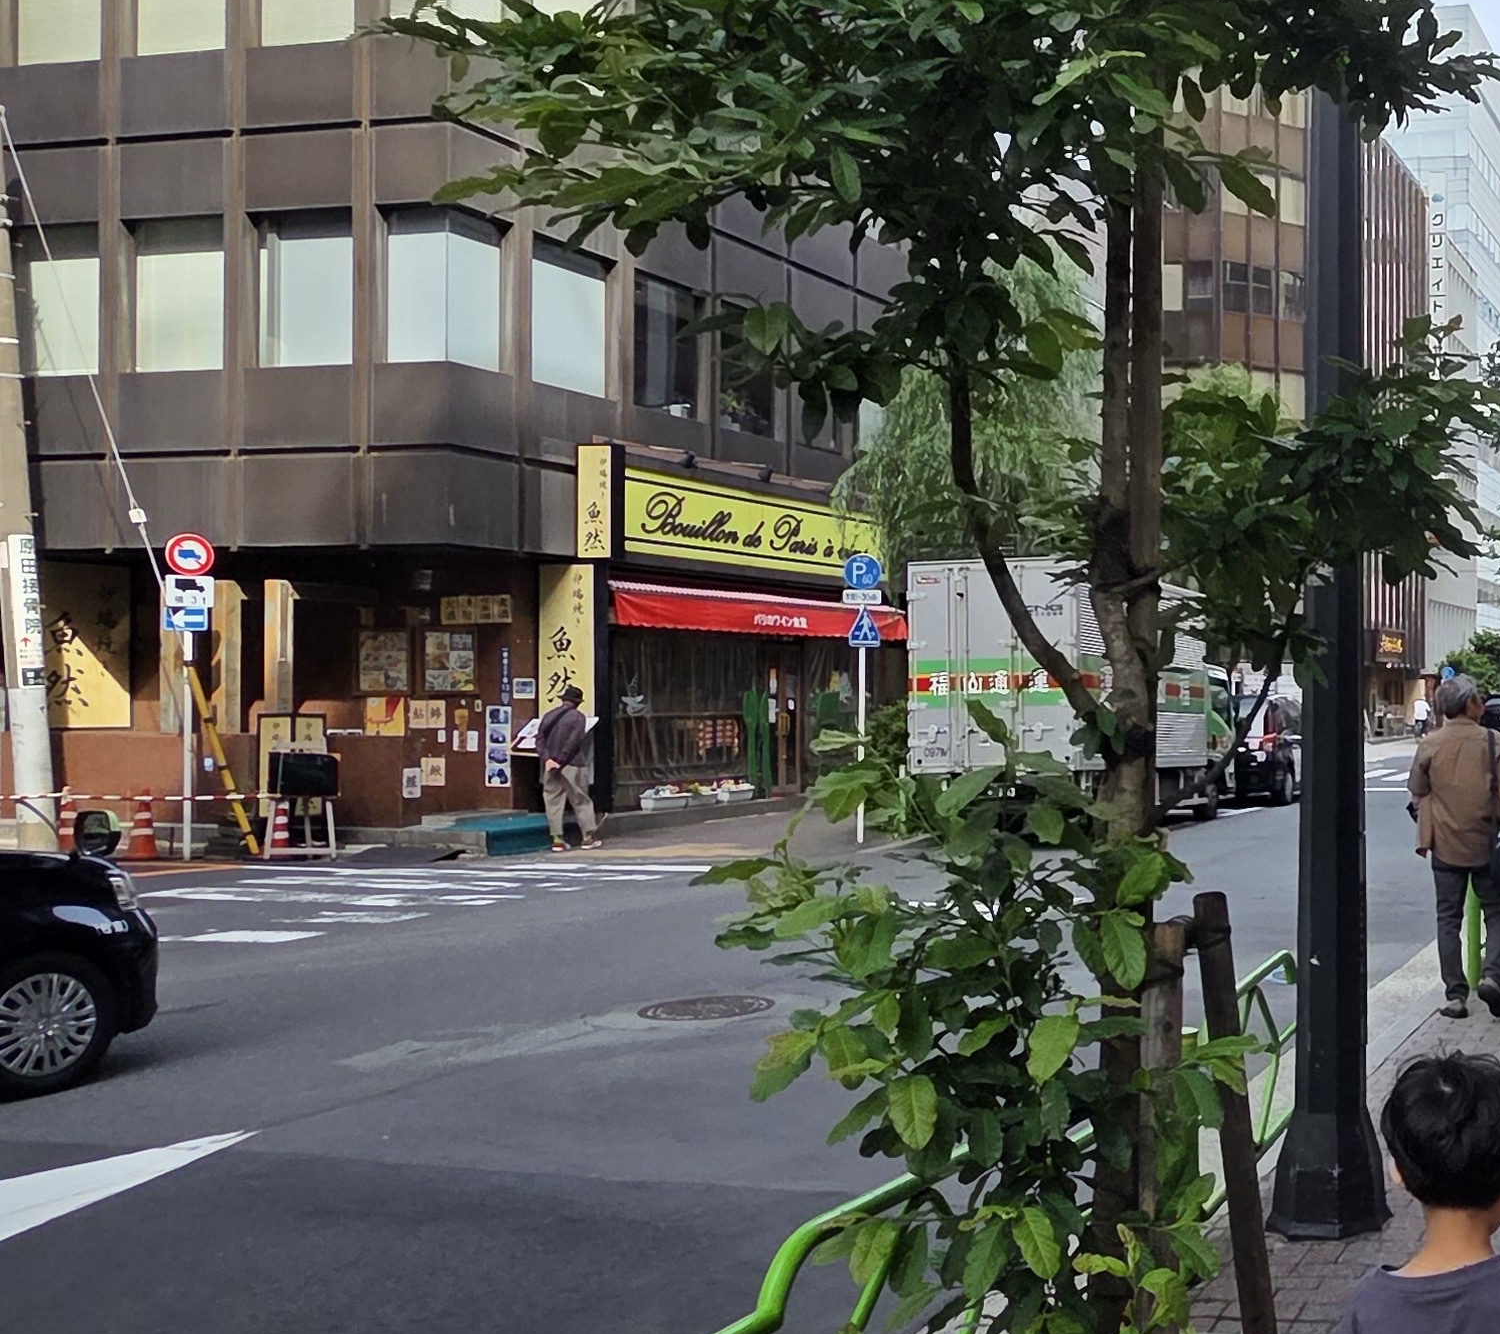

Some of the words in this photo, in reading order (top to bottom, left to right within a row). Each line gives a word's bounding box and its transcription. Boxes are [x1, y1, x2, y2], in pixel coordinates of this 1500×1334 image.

[641, 491, 739, 545] Bouillon
[770, 514, 818, 555] Paris
[852, 562, 867, 584] P
[928, 668, 1051, 697] 福山通運
